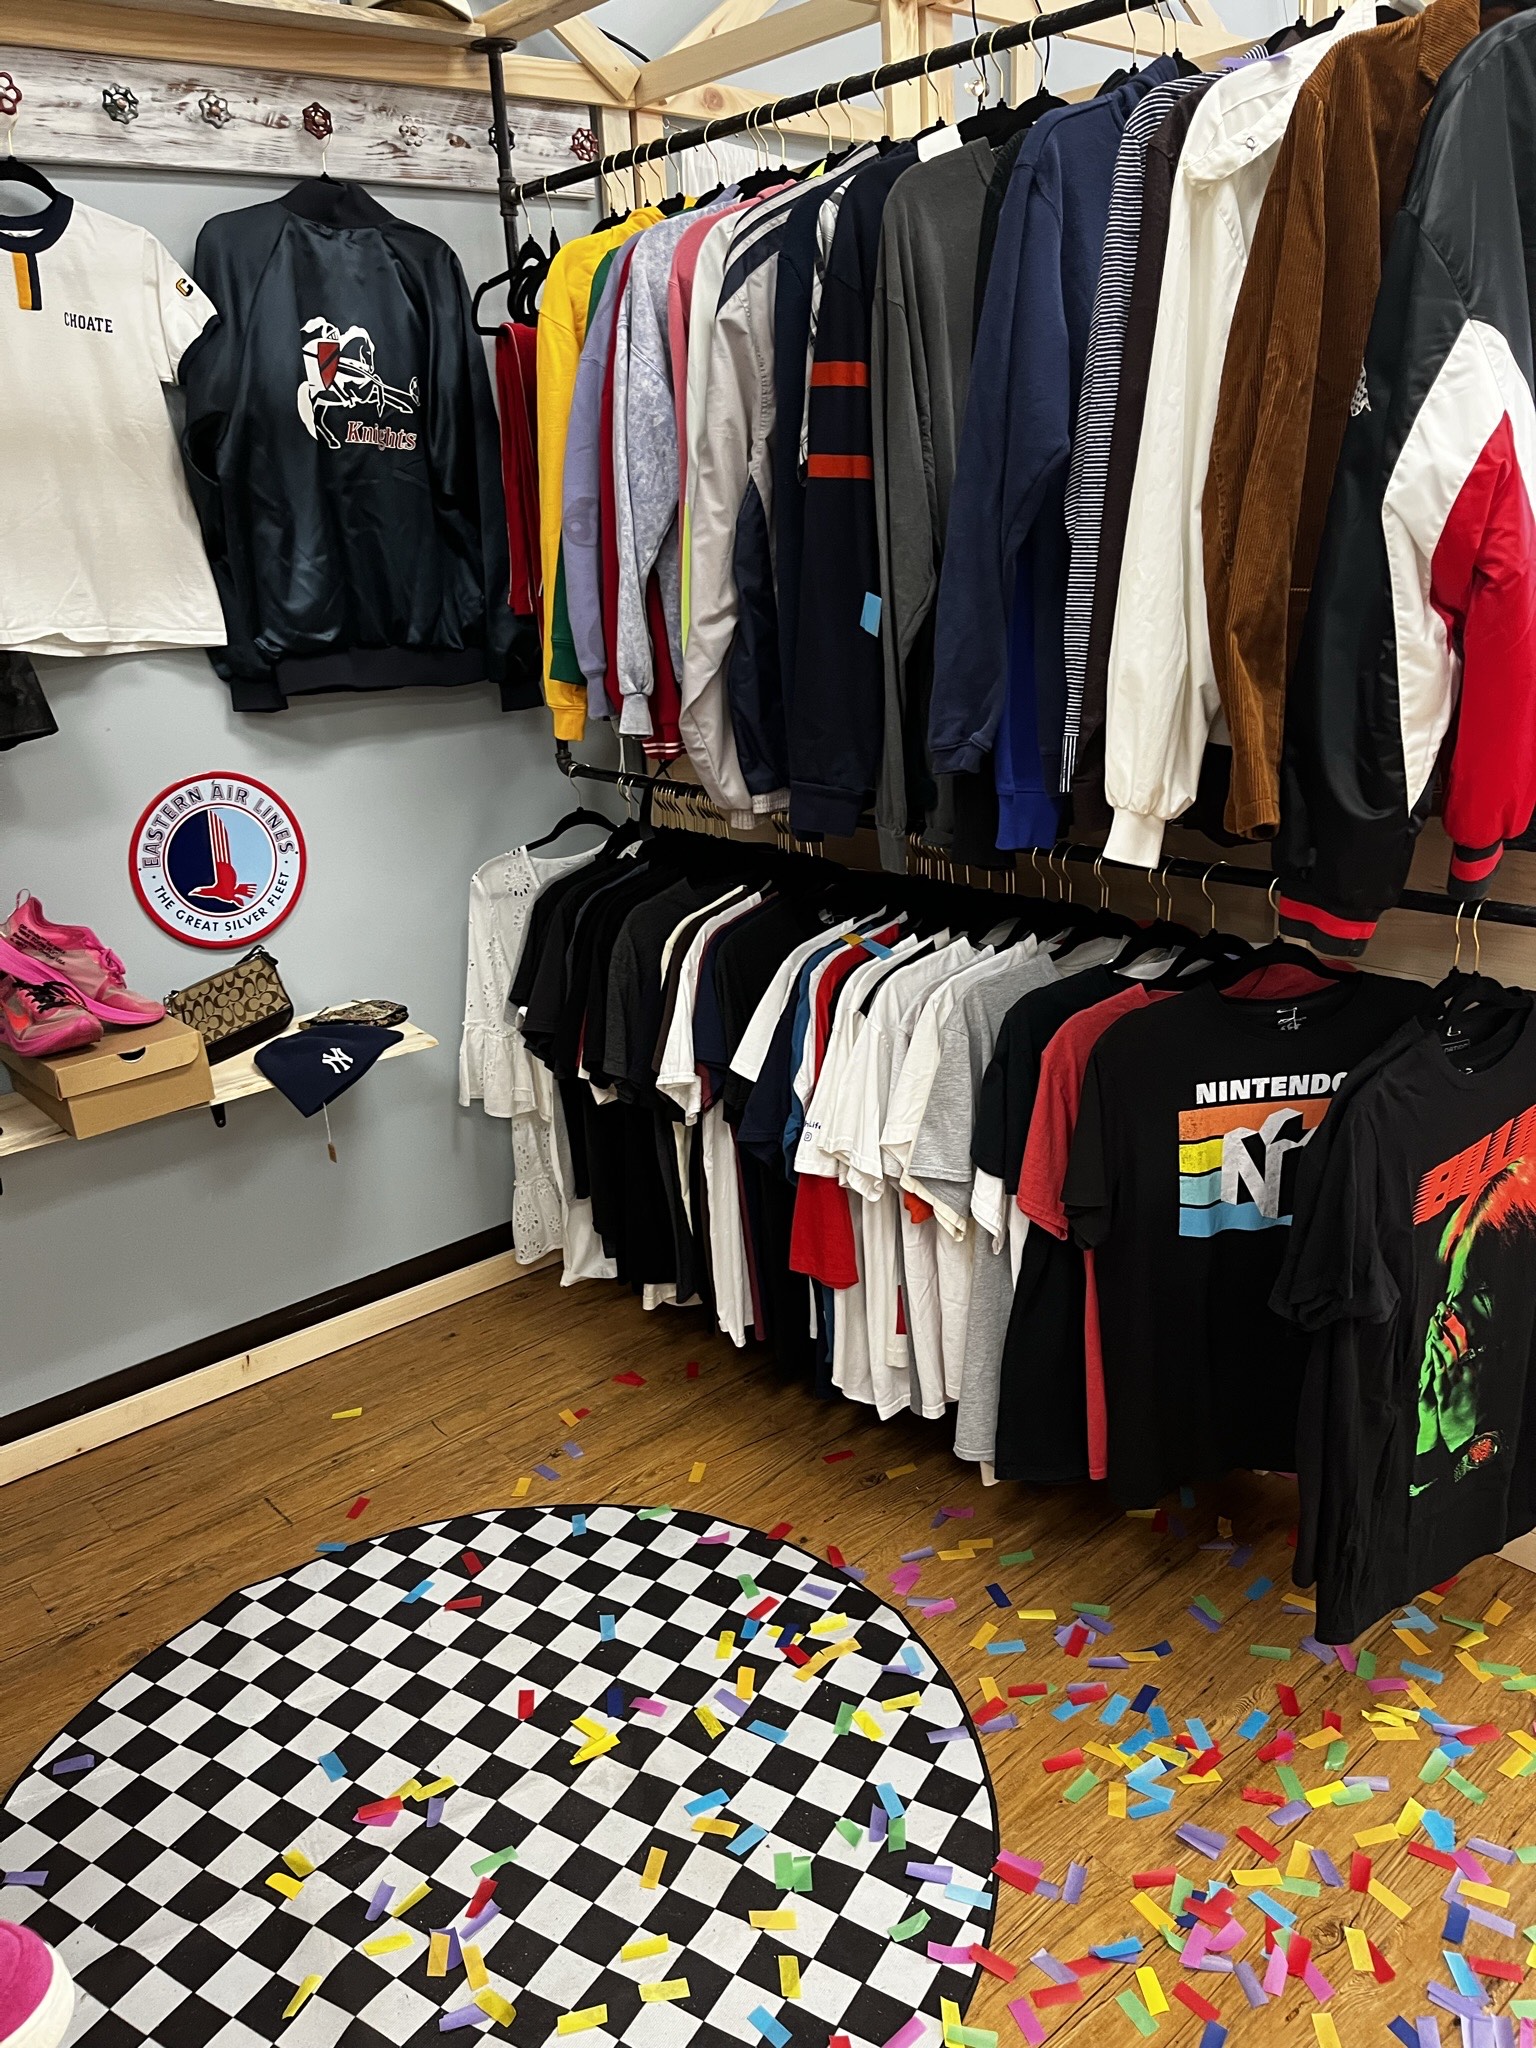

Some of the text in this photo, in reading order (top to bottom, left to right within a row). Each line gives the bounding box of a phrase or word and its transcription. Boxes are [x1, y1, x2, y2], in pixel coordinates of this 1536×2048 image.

[63, 311, 114, 333] CHOATE
[345, 420, 417, 451] Knights
[142, 783, 295, 869] EASTERN AIR LINES
[154, 872, 290, 932] THE GREAT SILVER FLEET
[322, 1047, 354, 1074] NY
[1412, 1103, 1536, 1225] BILLI
